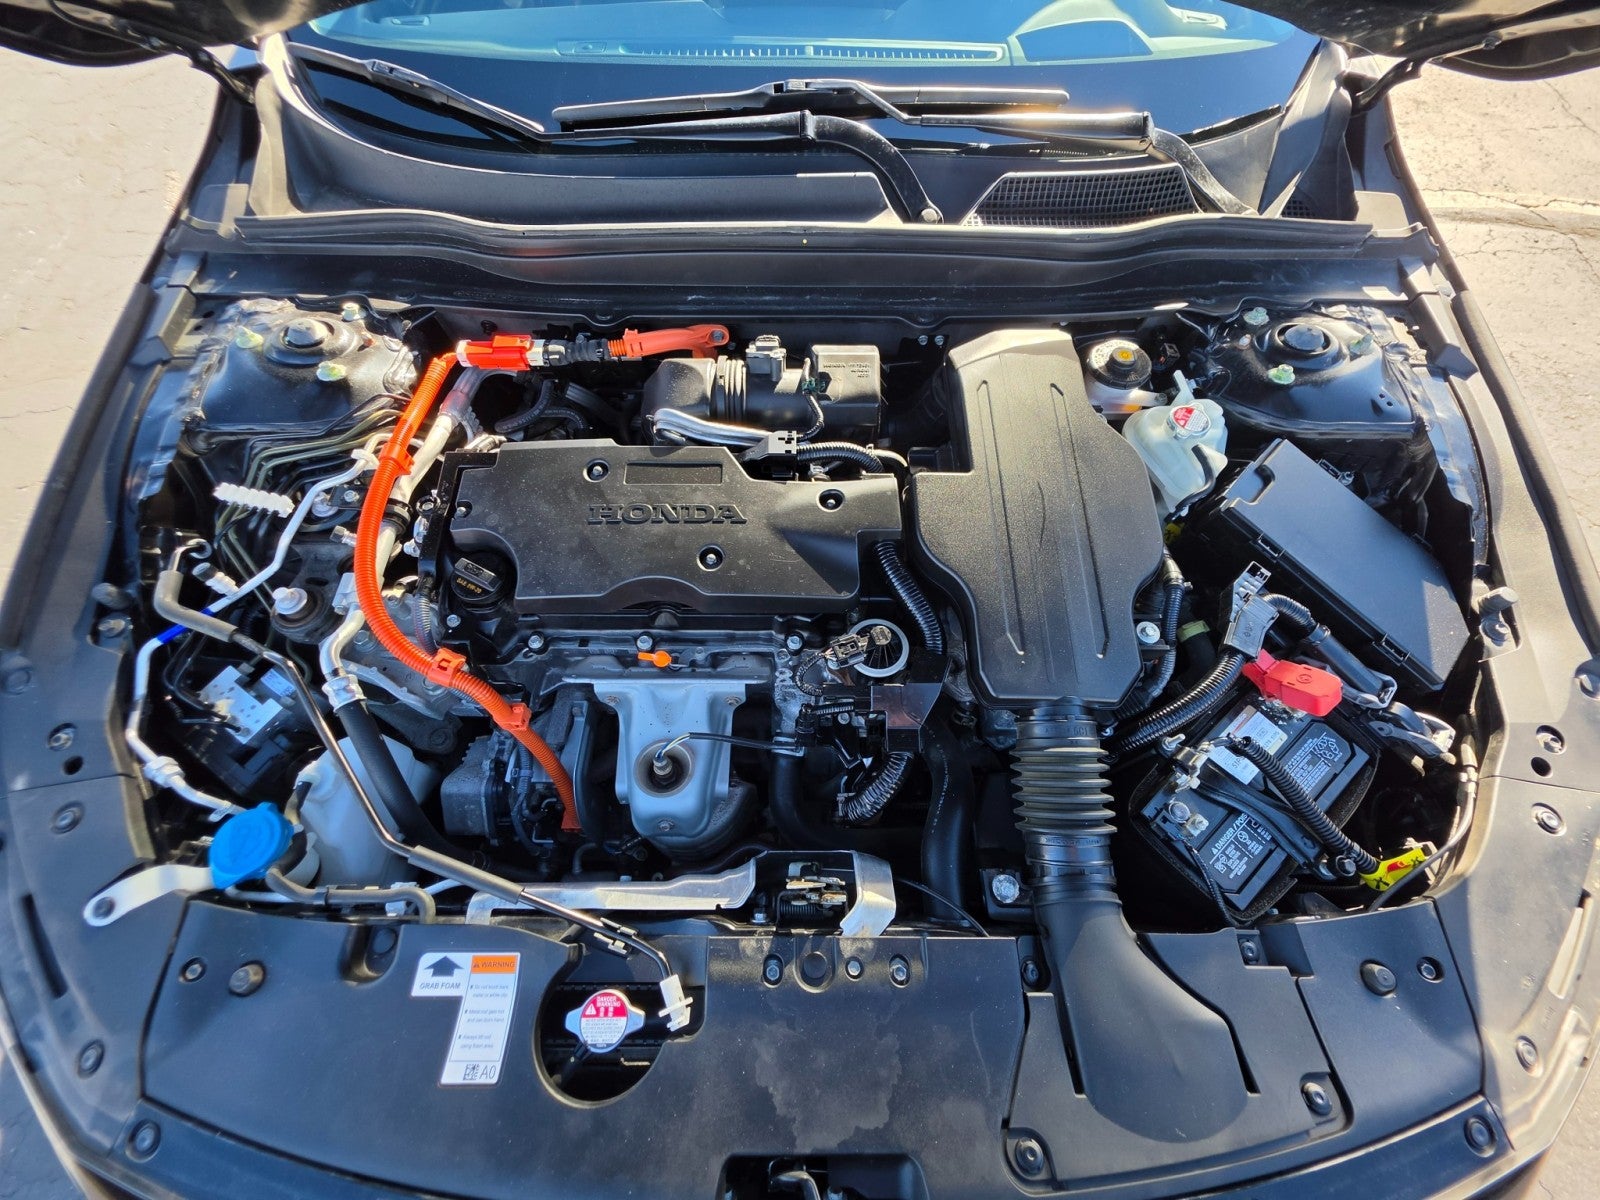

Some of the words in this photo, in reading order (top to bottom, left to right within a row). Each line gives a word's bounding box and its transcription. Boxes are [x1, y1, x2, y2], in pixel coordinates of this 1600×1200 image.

[587, 503, 748, 525] HONDA
[419, 982, 440, 990] GRAB
[440, 982, 461, 990] FOAM
[479, 1064, 497, 1080] A0
